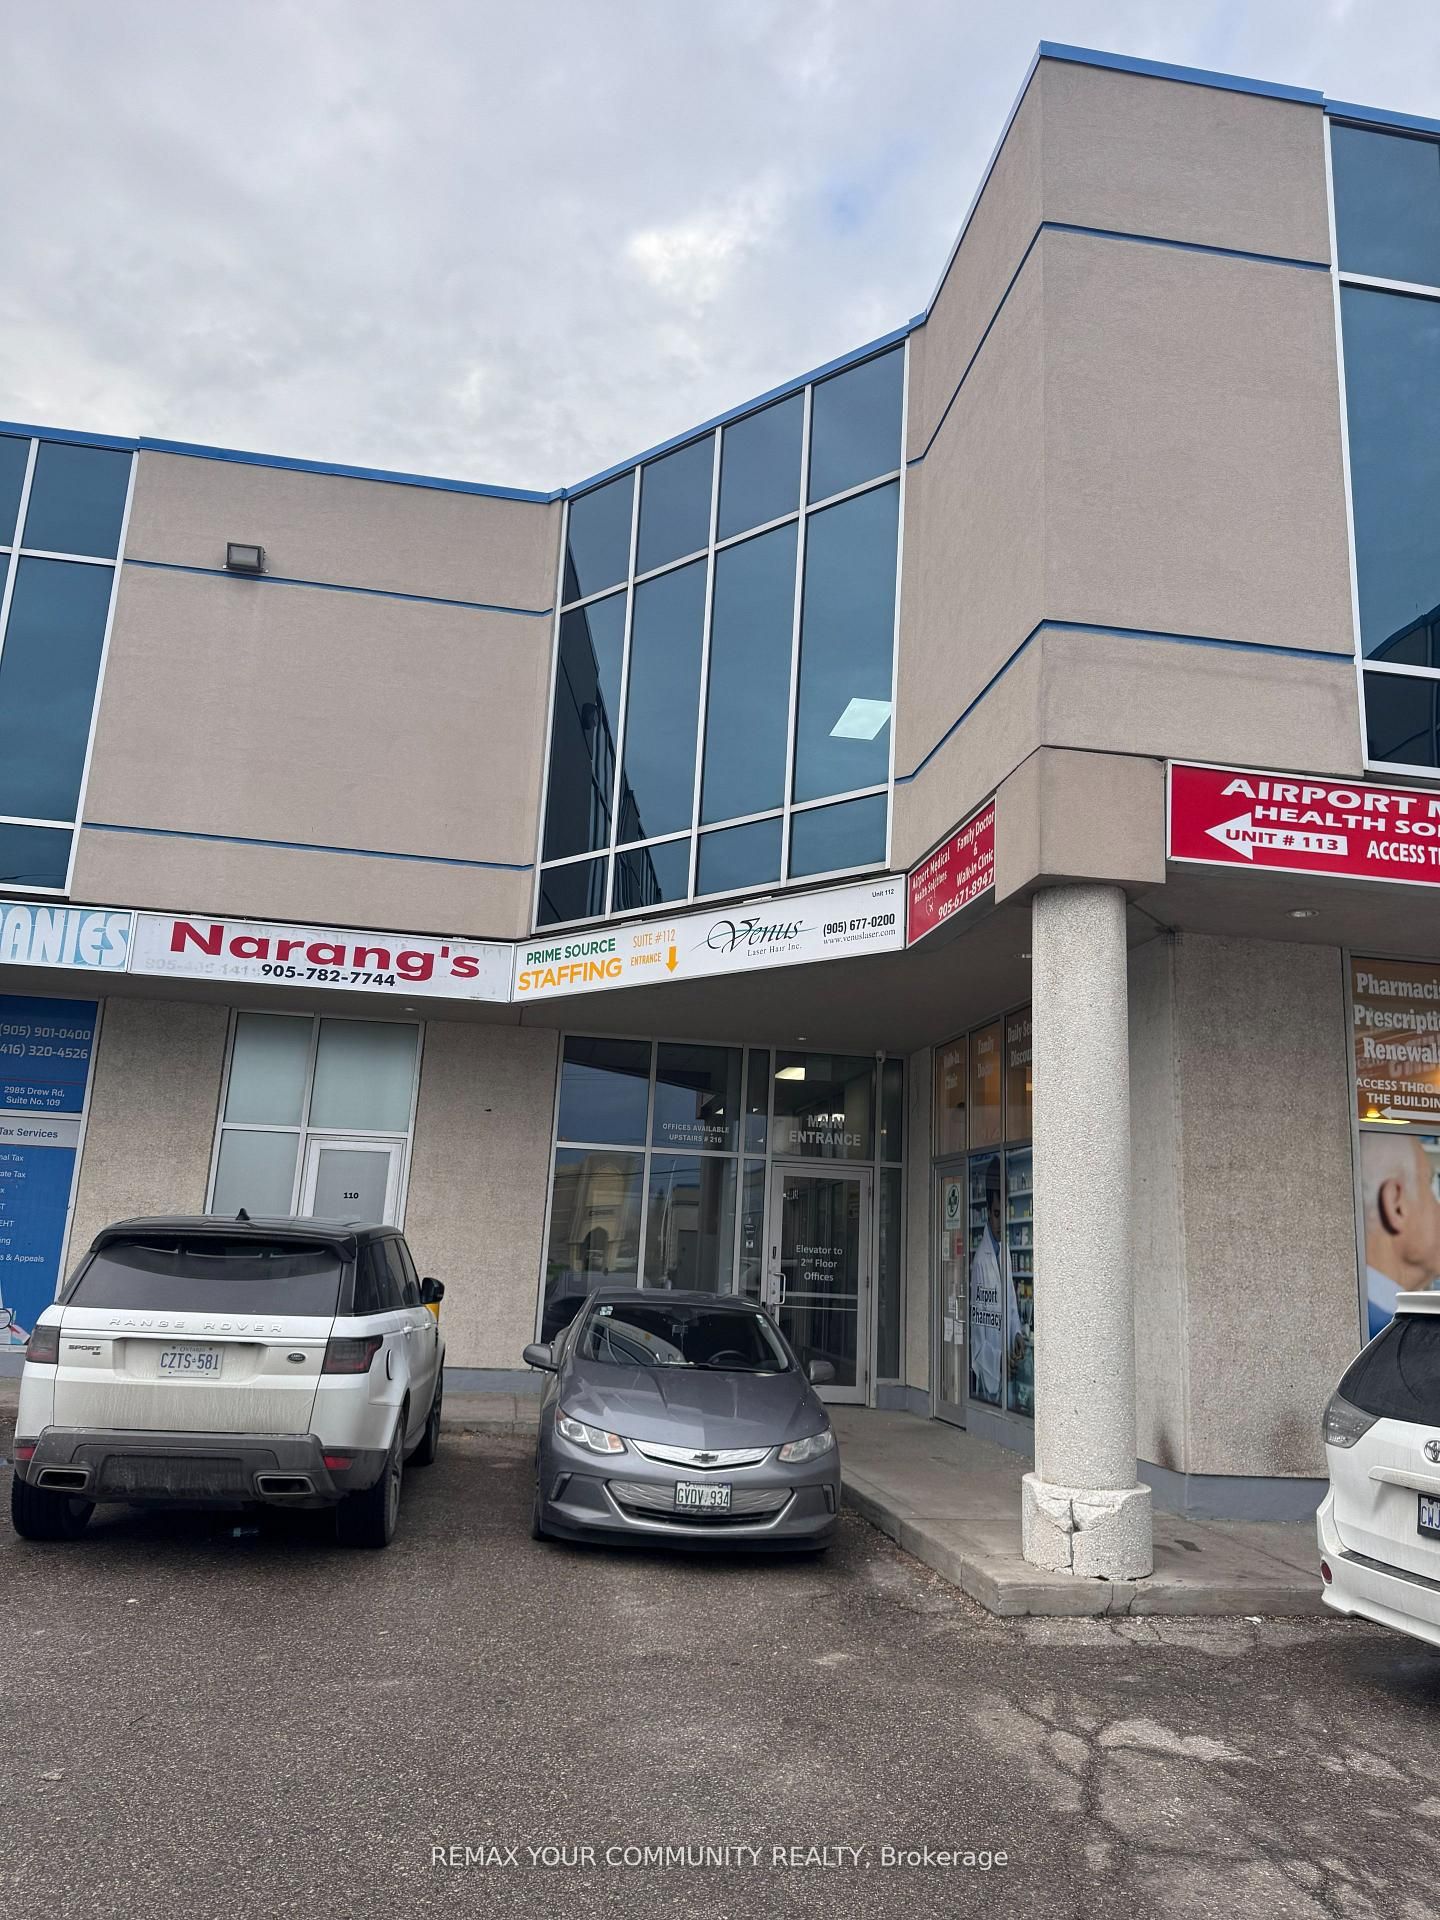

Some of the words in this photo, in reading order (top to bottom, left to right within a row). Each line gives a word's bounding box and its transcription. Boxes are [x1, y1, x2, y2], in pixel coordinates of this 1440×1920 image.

[1221, 778, 1417, 815] AIRPORT
[1255, 805, 1386, 832] HEALTH
[1395, 820, 1440, 838] SO
[957, 826, 975, 852] Family
[975, 810, 994, 837] Doctor
[1226, 828, 1277, 845] UNIT
[1283, 835, 1294, 847] #
[1303, 837, 1339, 851] 113
[1367, 841, 1425, 864] ACCESS
[1428, 846, 1440, 865] T
[912, 866, 930, 891] Airport
[930, 846, 950, 874] Medical
[956, 861, 977, 887] Walk-In
[977, 848, 994, 871] Clinic
[872, 890, 884, 898] Unit
[914, 885, 928, 904] Health
[938, 867, 994, 920] 905-671-8947
[823, 921, 847, 937] (905)
[849, 913, 896, 931] 677-0200
[0, 906, 131, 967] ANIES
[633, 932, 653, 948] SUITE
[655, 928, 676, 944] #112
[707, 917, 803, 953] Venus
[823, 928, 896, 945] www.venuslaser.com
[170, 921, 480, 982] Narang's
[526, 947, 561, 965] PRIME
[565, 938, 616, 959] SOURCE
[747, 947, 766, 957] Laser
[769, 945, 785, 953] Hair
[788, 942, 802, 951] Inc.
[630, 952, 662, 967] ENTRANCE
[261, 964, 396, 987] 905-782-7744
[517, 957, 622, 991] STAFFING
[1356, 973, 1440, 999] Pharmaci
[0, 1023, 31, 1038] (905)
[34, 1026, 91, 1040] 901-0400
[28, 1045, 88, 1060] 320-4526
[27, 1087, 50, 1096] Drew
[1356, 1077, 1397, 1091] ACCESS
[6, 1096, 28, 1105] Suite
[30, 1097, 44, 1106] No.
[46, 1099, 61, 1107] 109
[1366, 1093, 1391, 1105] THE
[662, 1123, 691, 1131] OFFICES
[693, 1125, 729, 1133] AVAILABLE
[807, 1114, 843, 1129] MAIN
[0, 1127, 14, 1136] Tax
[16, 1128, 58, 1139] Services
[669, 1134, 702, 1142] UPSTAIRS
[789, 1130, 861, 1146] ENTRANCE
[12, 1154, 24, 1162] Tax
[14, 1170, 26, 1179] Tax
[796, 1244, 831, 1254] Elevator
[833, 1247, 843, 1255] to
[14, 1254, 45, 1264] Appeals
[815, 1258, 838, 1268] Floor
[803, 1272, 834, 1282] Offices
[976, 1286, 997, 1305] Airport
[109, 1318, 186, 1329] RANGE
[203, 1321, 282, 1333] ROVER
[972, 1306, 1003, 1331] Pharmacy
